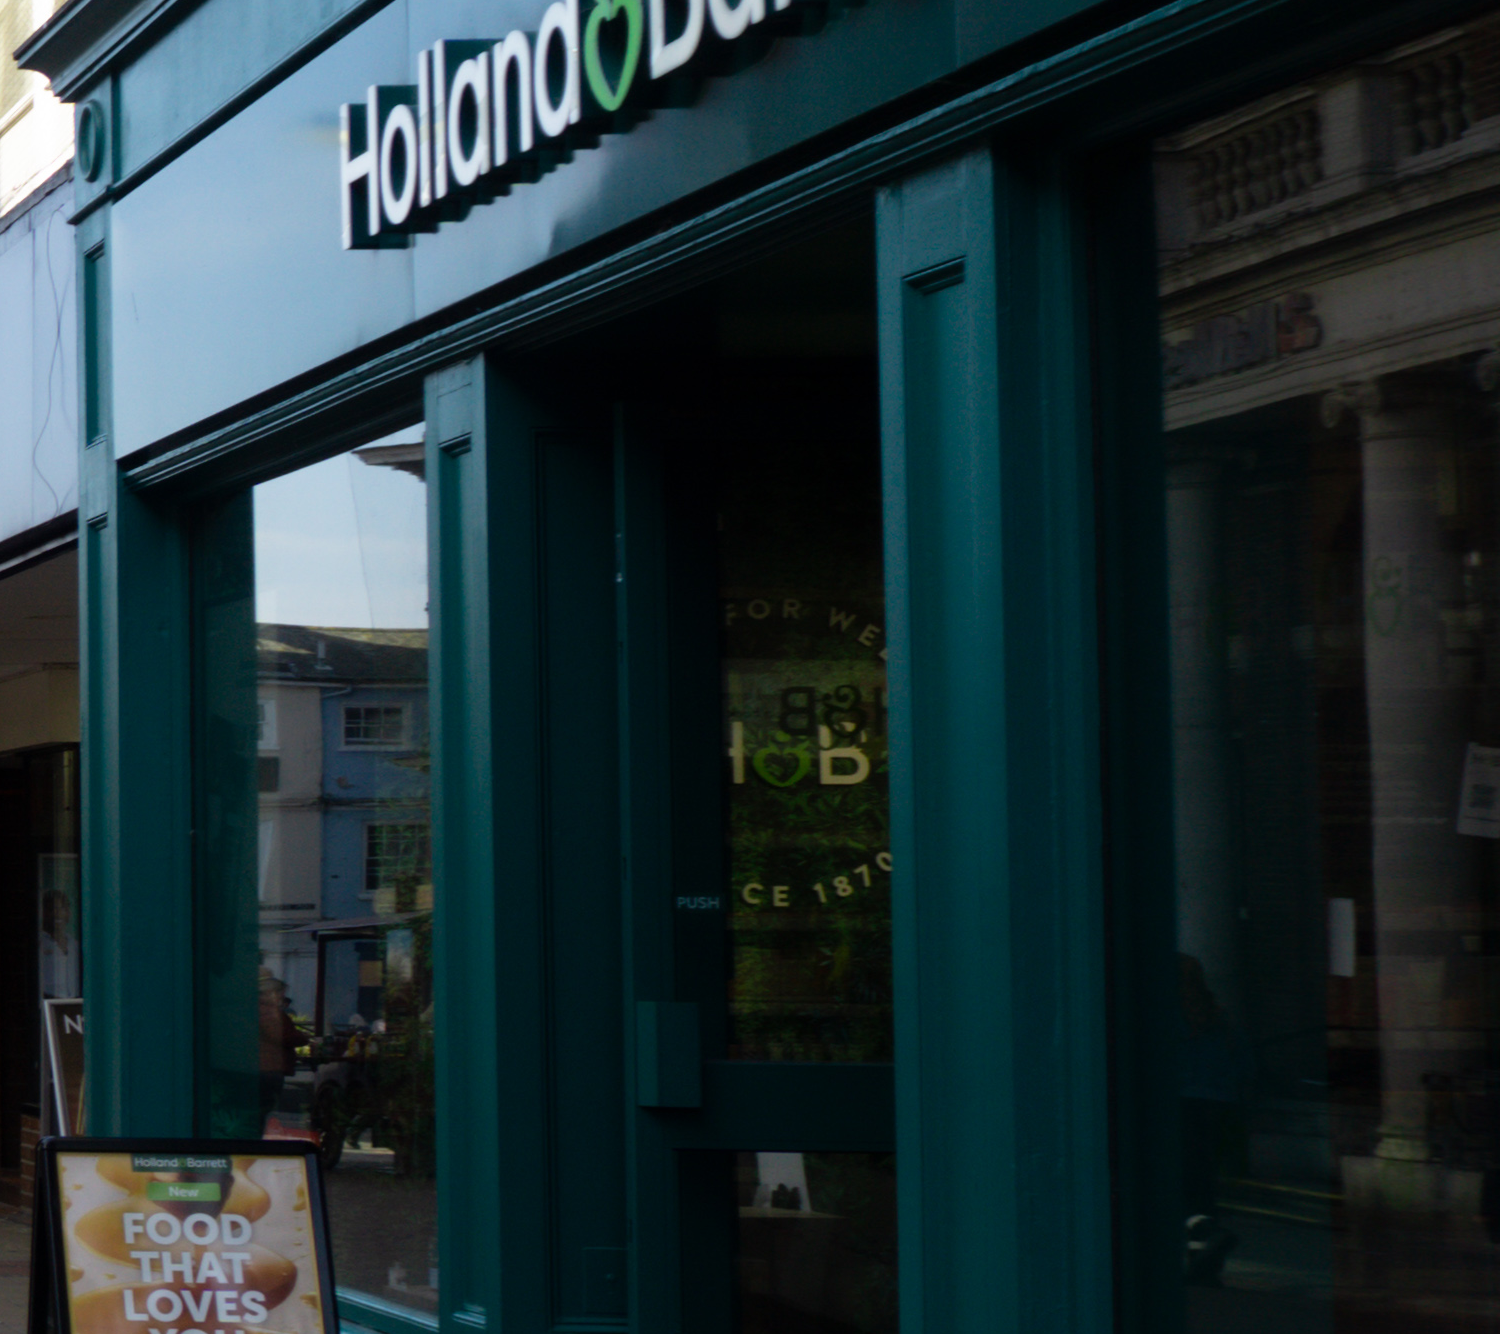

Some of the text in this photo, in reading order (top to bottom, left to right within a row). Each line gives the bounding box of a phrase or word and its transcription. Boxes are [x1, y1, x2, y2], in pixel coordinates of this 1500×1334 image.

[676, 896, 721, 910] PUSH
[134, 1157, 178, 1167] Holland
[186, 1157, 228, 1168] Barrett
[168, 1186, 199, 1197] New
[122, 1212, 252, 1246] FOOD
[129, 1251, 251, 1284] THAT
[122, 1288, 268, 1324] LOVES
